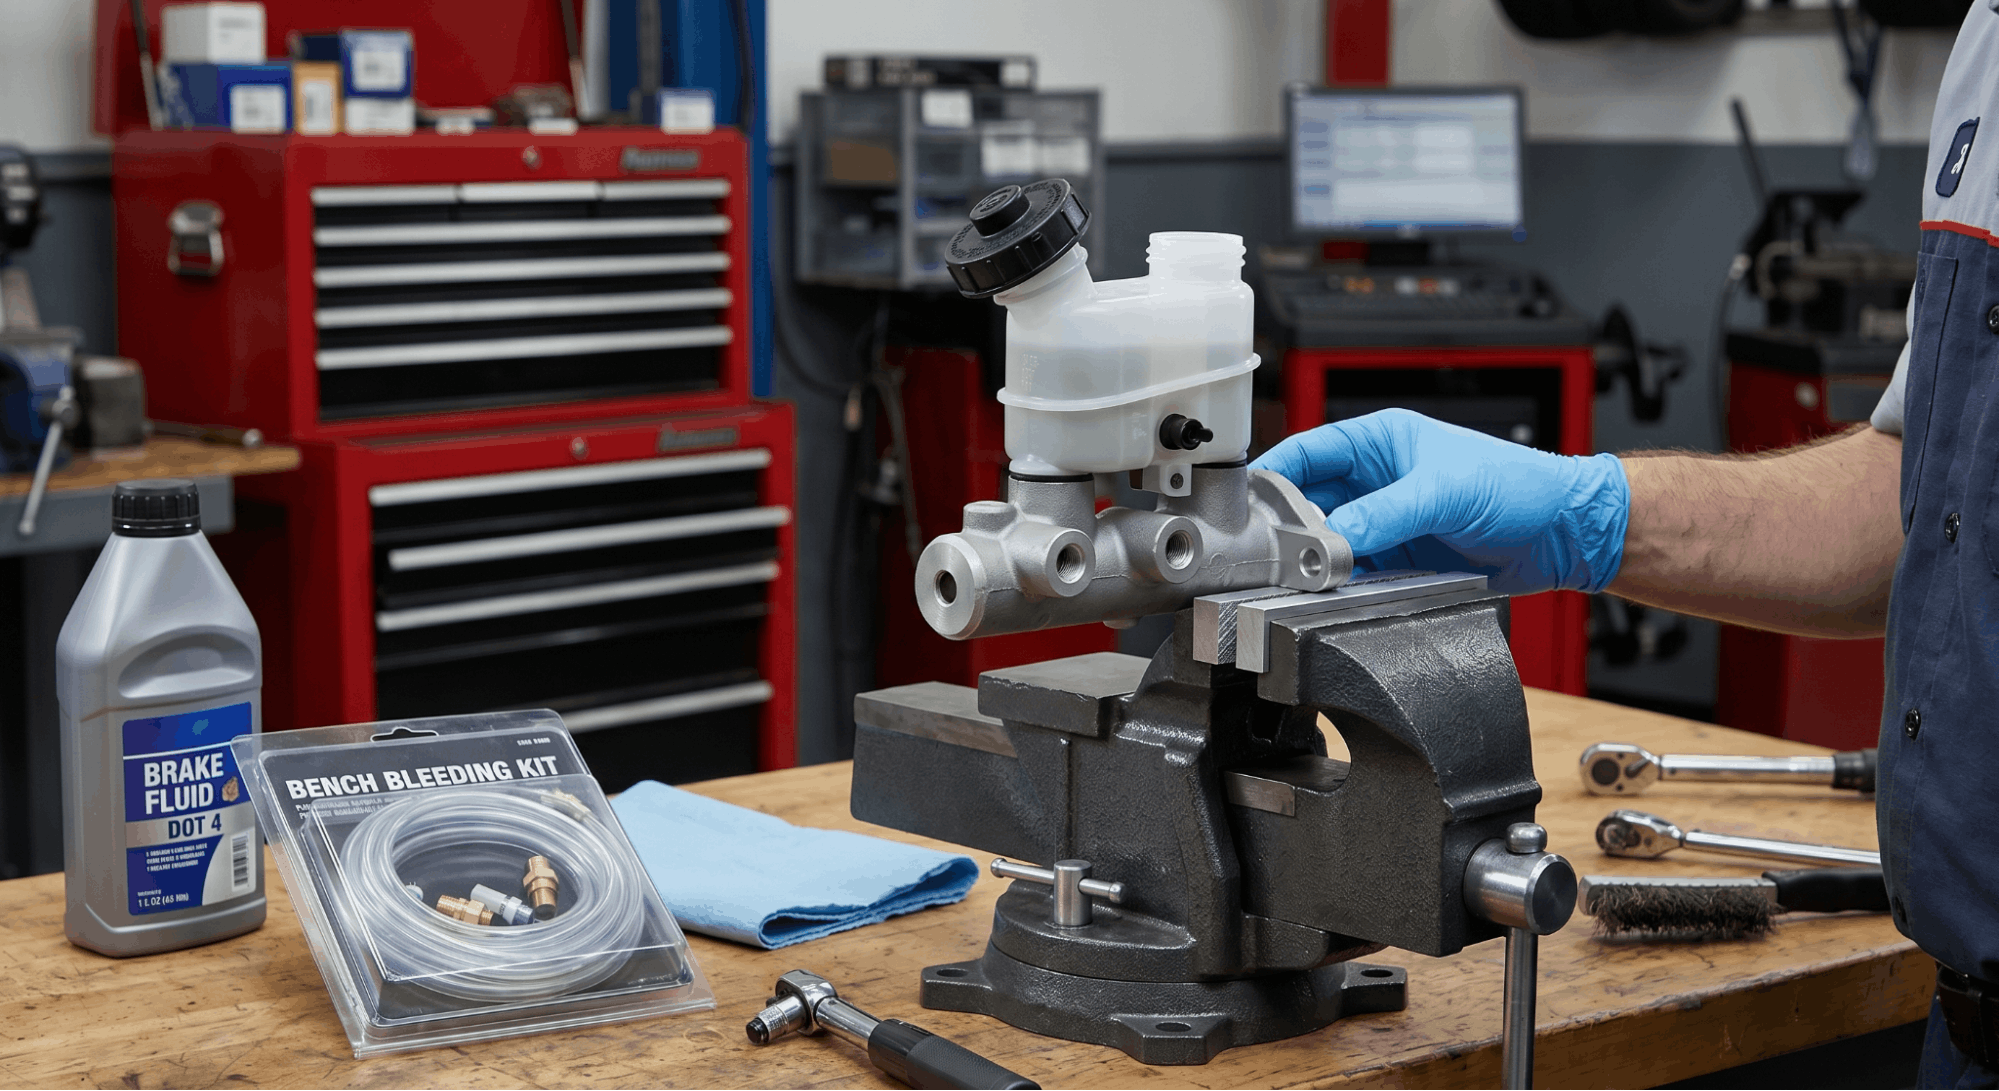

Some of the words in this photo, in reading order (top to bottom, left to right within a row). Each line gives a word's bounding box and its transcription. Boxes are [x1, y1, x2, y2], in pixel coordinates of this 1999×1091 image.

[144, 752, 224, 787] BRAKE
[285, 773, 379, 800] BENCH
[382, 760, 514, 791] BLEEDING
[515, 755, 559, 778] KIT
[145, 782, 214, 815] FLUID
[168, 815, 206, 839] DOT
[211, 812, 222, 832] 4
[150, 896, 161, 906] OZ
